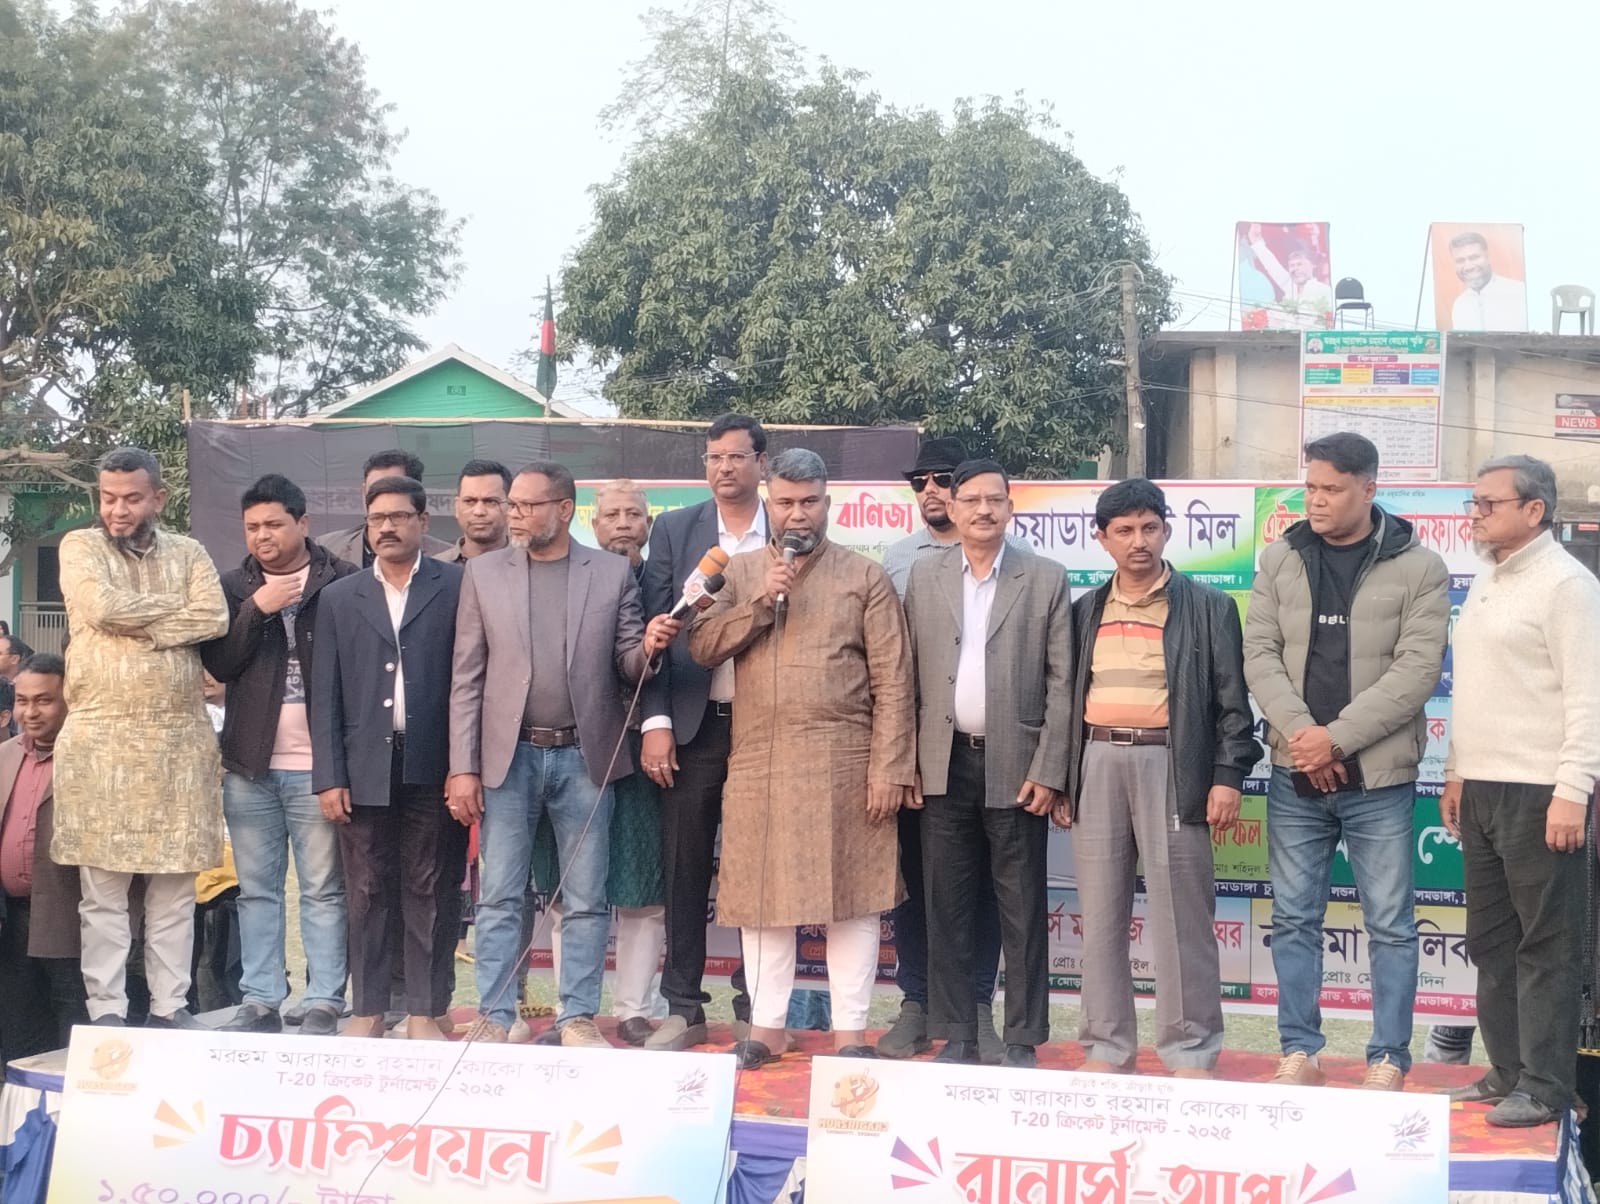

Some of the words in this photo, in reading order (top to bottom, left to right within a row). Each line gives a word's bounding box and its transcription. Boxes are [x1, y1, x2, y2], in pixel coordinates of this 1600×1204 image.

[1561, 417, 1597, 428] NEWS
[1184, 499, 1241, 551] মিল
[209, 1048, 265, 1063] মরহুম
[276, 1050, 367, 1069] আরাফাত
[377, 1056, 442, 1072] রহমান
[276, 1071, 315, 1087] T-20
[323, 1071, 372, 1089] ক্রিকেট
[459, 1083, 504, 1097] ২০২৫
[944, 1084, 1001, 1103] মরহুম
[1010, 1086, 1098, 1109] আরাফাত
[1106, 1091, 1171, 1115] রহমান
[1180, 1099, 1248, 1121] কোকো
[1257, 1100, 1305, 1130] স্মৃতি
[219, 1095, 552, 1185] চ্যাম্পিয়ন
[1011, 1111, 1049, 1128] T-20
[1056, 1112, 1104, 1131] ক্রিকেট
[1110, 1113, 1168, 1136] টুর্নামেন্ট
[1187, 1124, 1231, 1141] ২০২৫
